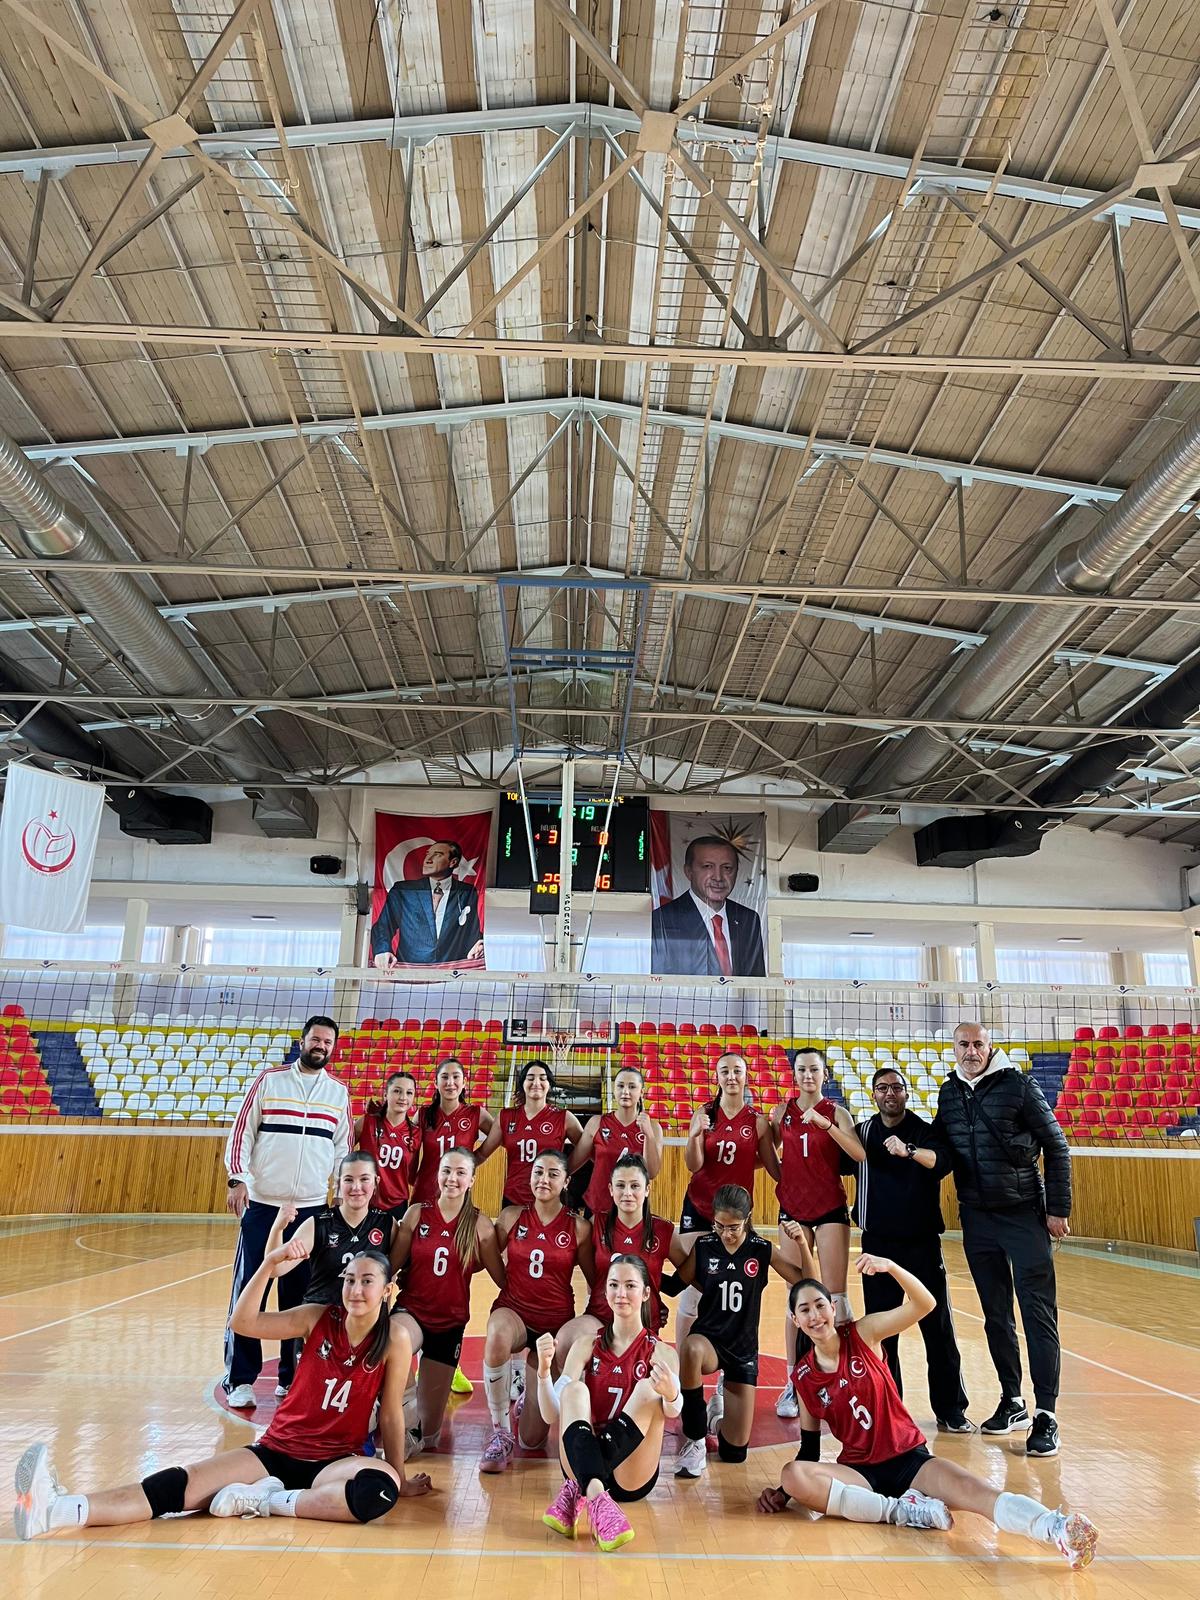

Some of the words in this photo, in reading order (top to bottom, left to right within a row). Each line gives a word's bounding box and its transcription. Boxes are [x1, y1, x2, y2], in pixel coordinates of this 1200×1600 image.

[548, 830, 558, 844] 3
[378, 1143, 404, 1170] 99
[516, 1138, 538, 1162] 19
[716, 1139, 737, 1165] 13
[799, 1132, 809, 1158] 1
[433, 1246, 450, 1277] 6
[528, 1249, 545, 1279] 8
[718, 1280, 743, 1313] 16
[321, 1377, 353, 1413] 14
[607, 1386, 623, 1420] 7
[848, 1395, 873, 1430] 5
